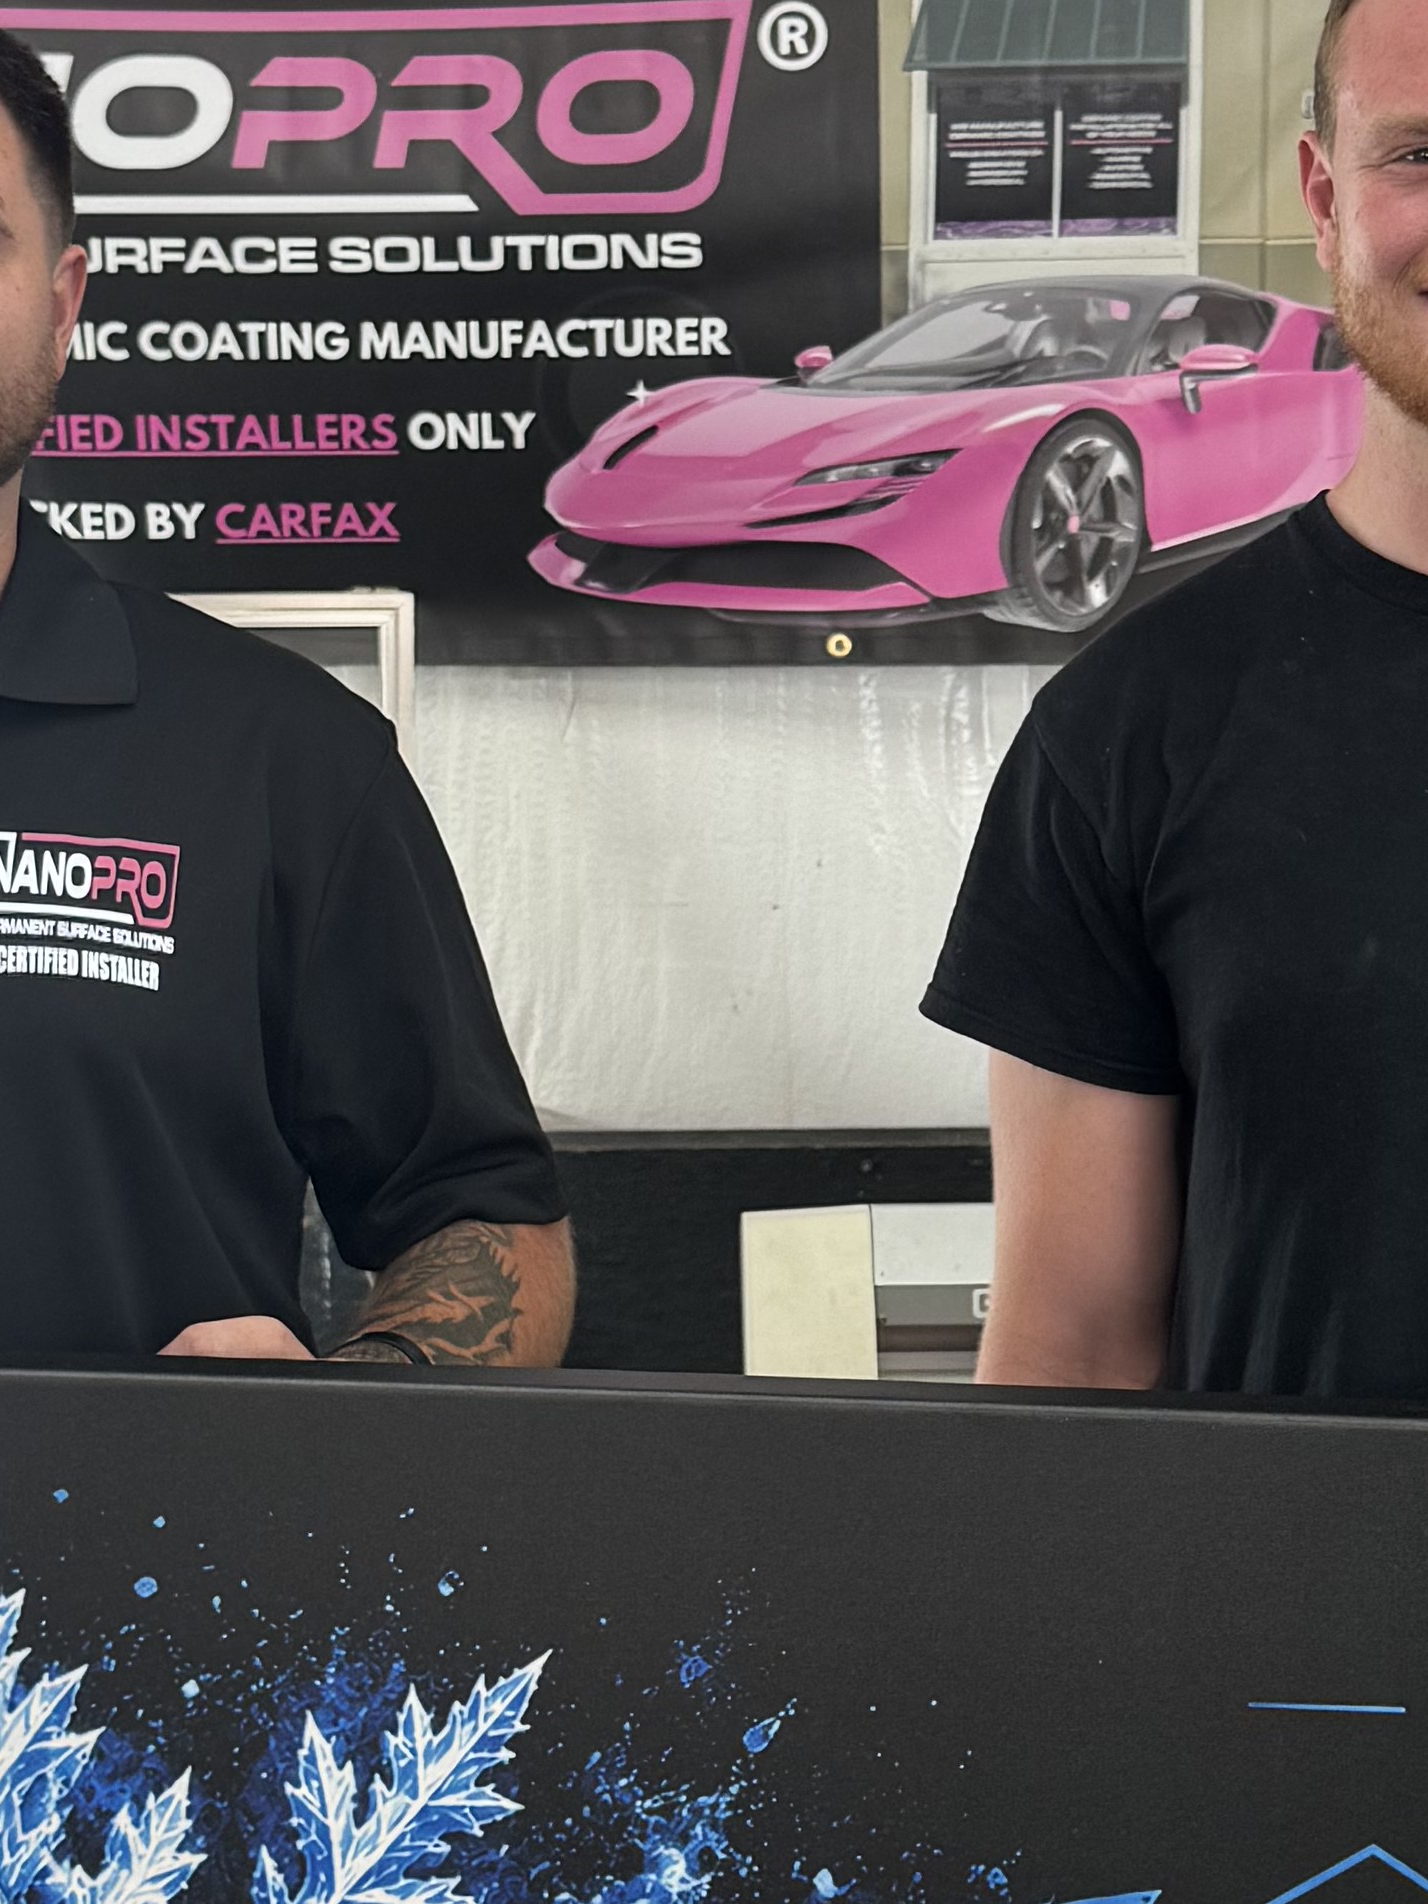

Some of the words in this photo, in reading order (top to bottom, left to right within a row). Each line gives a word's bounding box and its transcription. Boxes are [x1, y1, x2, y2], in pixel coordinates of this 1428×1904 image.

[86, 235, 318, 275] RFACE
[327, 232, 704, 275] SOLUTIONS
[136, 320, 350, 362] COATING
[360, 317, 731, 362] MANUFACTURER
[135, 413, 399, 452] INSTALLERS
[407, 411, 536, 451] ONLY
[29, 499, 137, 541] KED
[144, 501, 206, 541] BY
[215, 501, 399, 541] CARFAX
[57, 920, 112, 943] SURFACE
[113, 927, 176, 955] SOLUTIONS
[81, 949, 160, 991] INSTALLER
